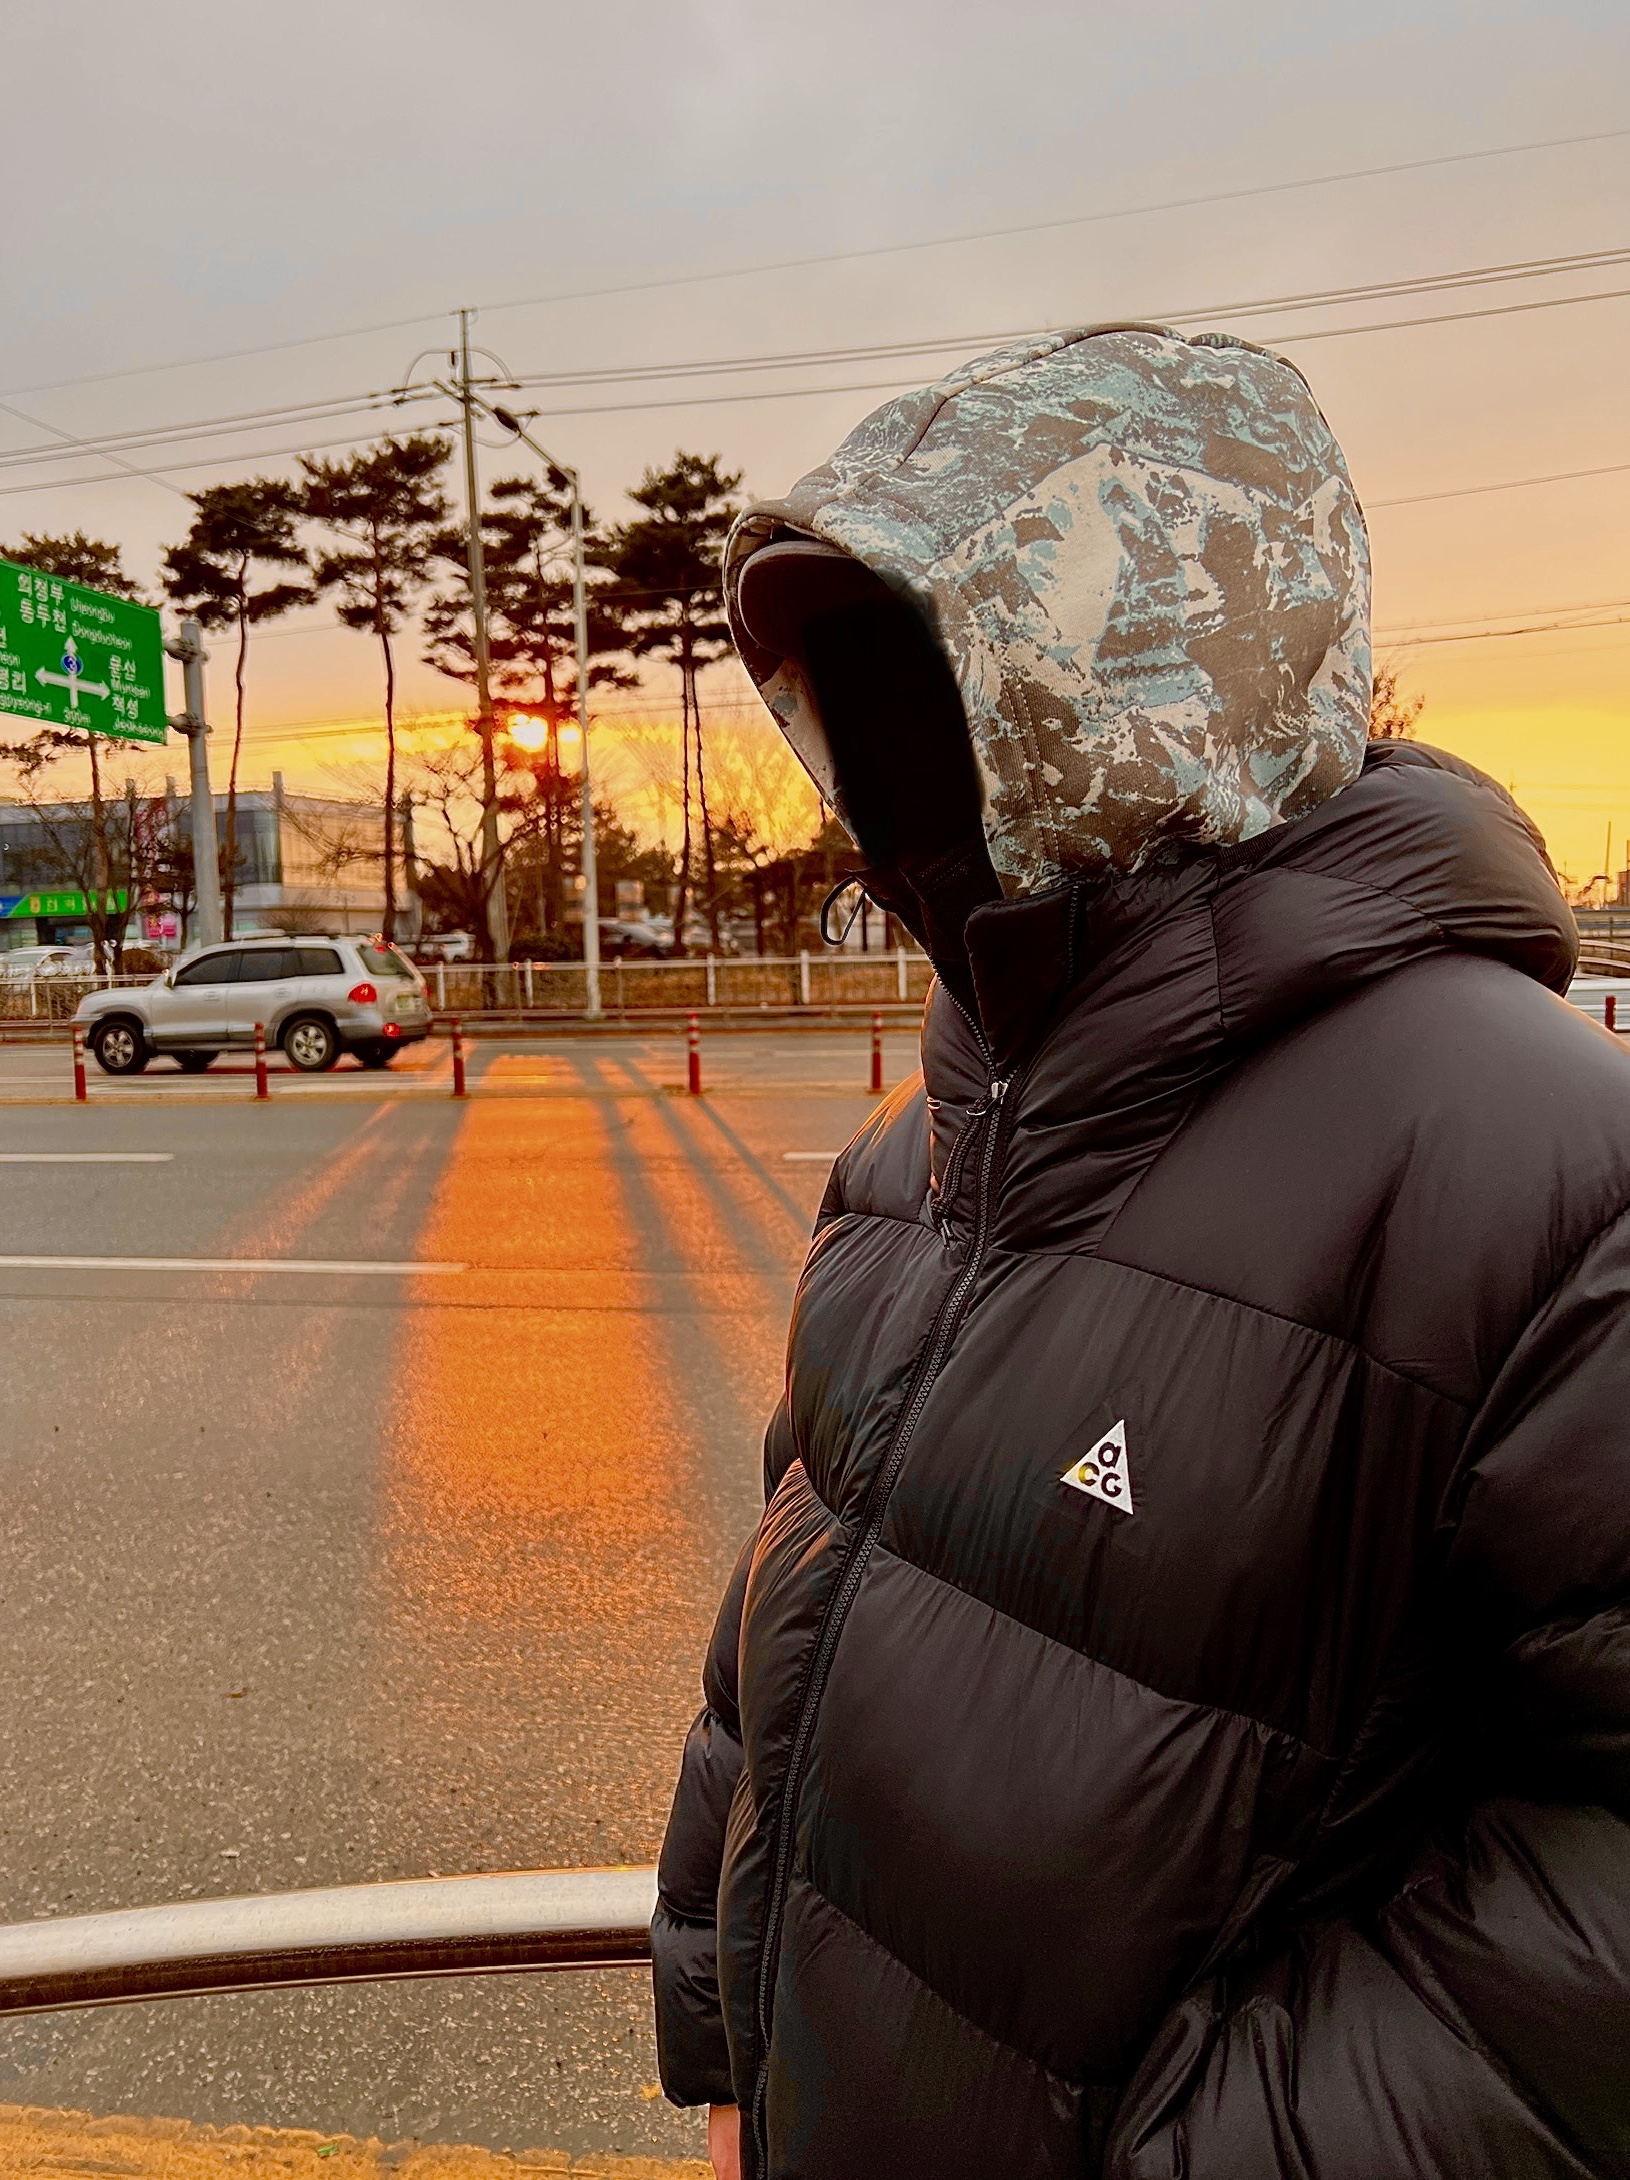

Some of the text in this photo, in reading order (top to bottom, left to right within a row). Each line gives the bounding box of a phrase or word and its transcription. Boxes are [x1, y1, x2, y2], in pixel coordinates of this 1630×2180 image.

[17, 573, 65, 607] 의정부
[19, 598, 67, 634] 동두천
[70, 597, 115, 624] Uijeongbu
[109, 655, 137, 682] 문산
